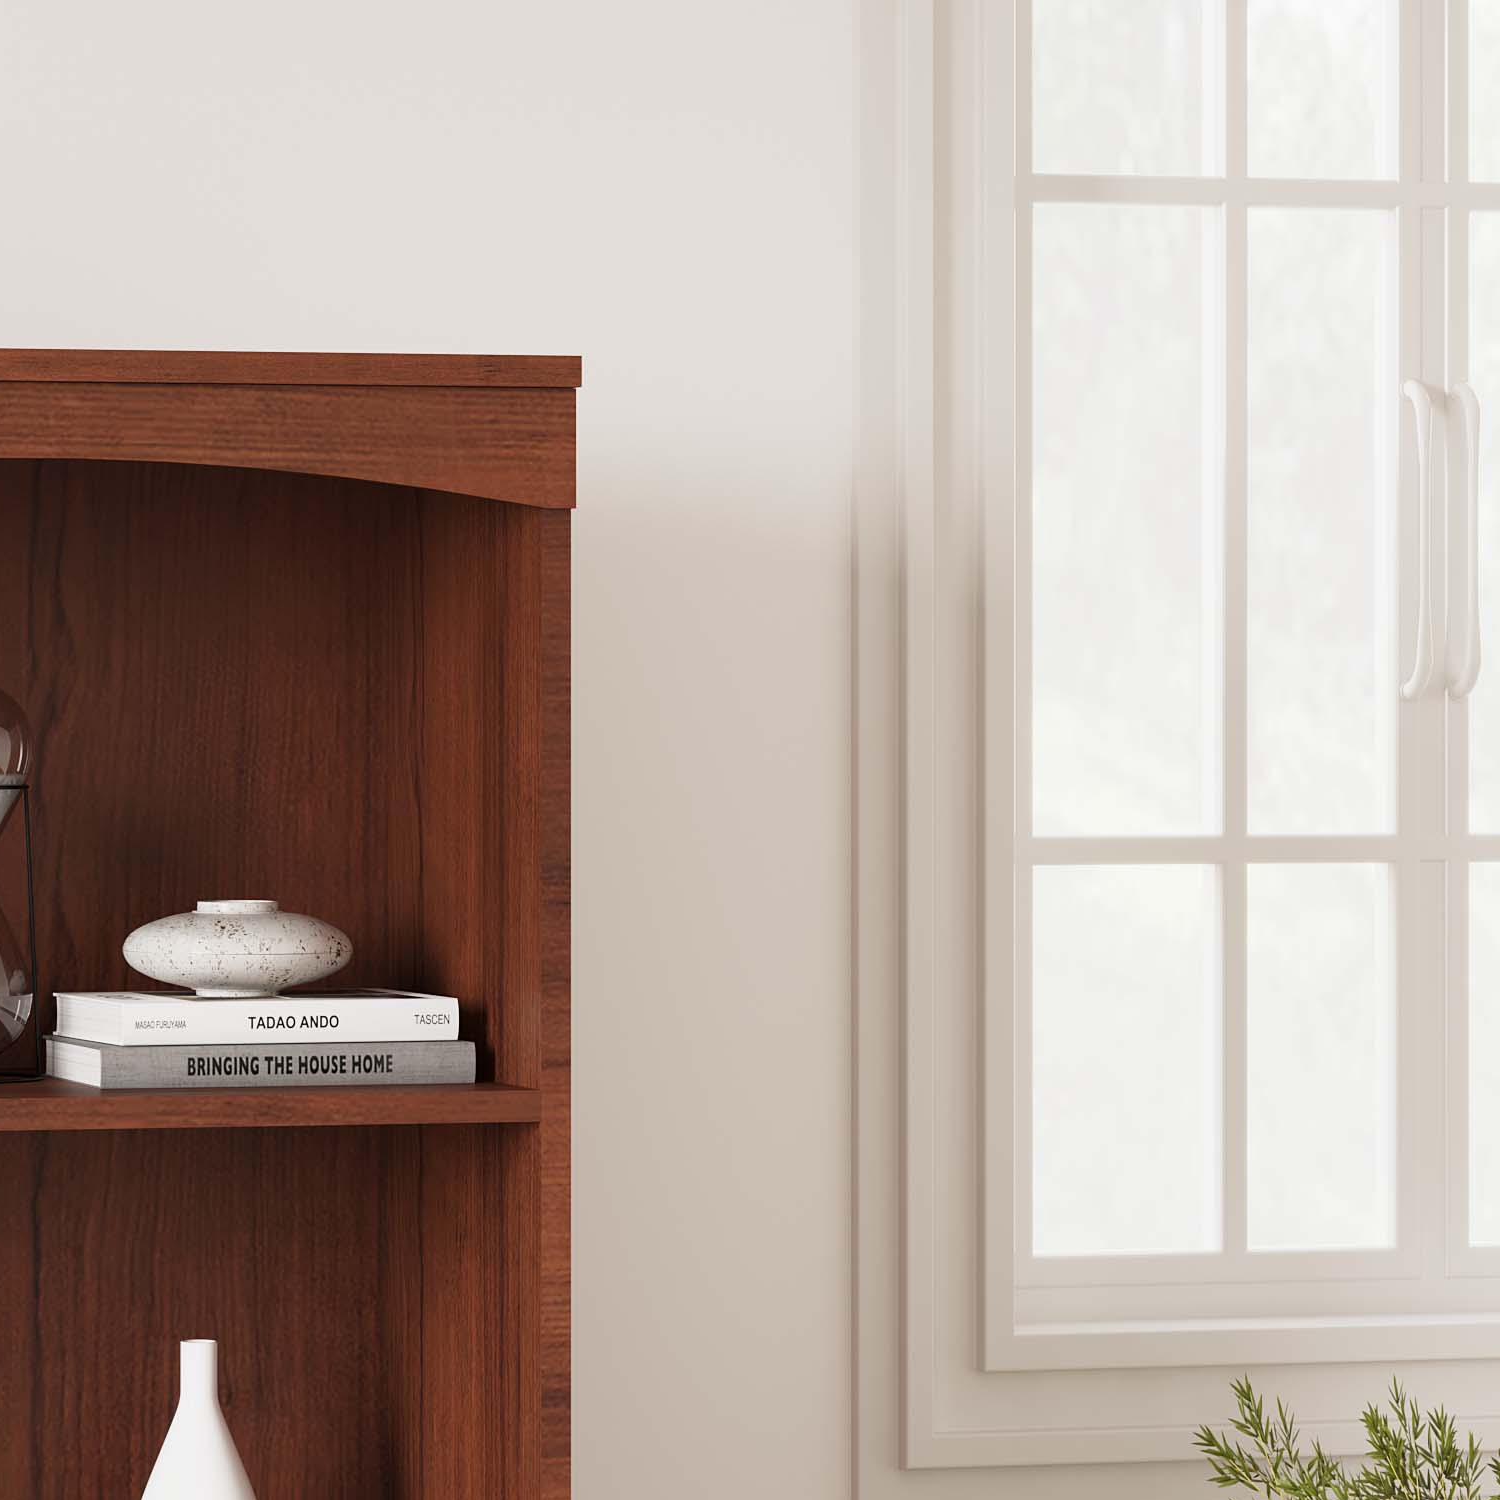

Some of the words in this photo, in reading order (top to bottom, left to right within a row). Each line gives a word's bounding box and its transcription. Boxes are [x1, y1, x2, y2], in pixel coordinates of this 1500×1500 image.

[248, 1015, 296, 1030] TADAO
[300, 1014, 339, 1029] ANDO
[414, 1013, 450, 1026] TASCEN
[187, 1055, 260, 1077] BRINGING
[264, 1055, 294, 1075] THE
[298, 1054, 347, 1075] HOUSE
[351, 1054, 393, 1074] HOME
